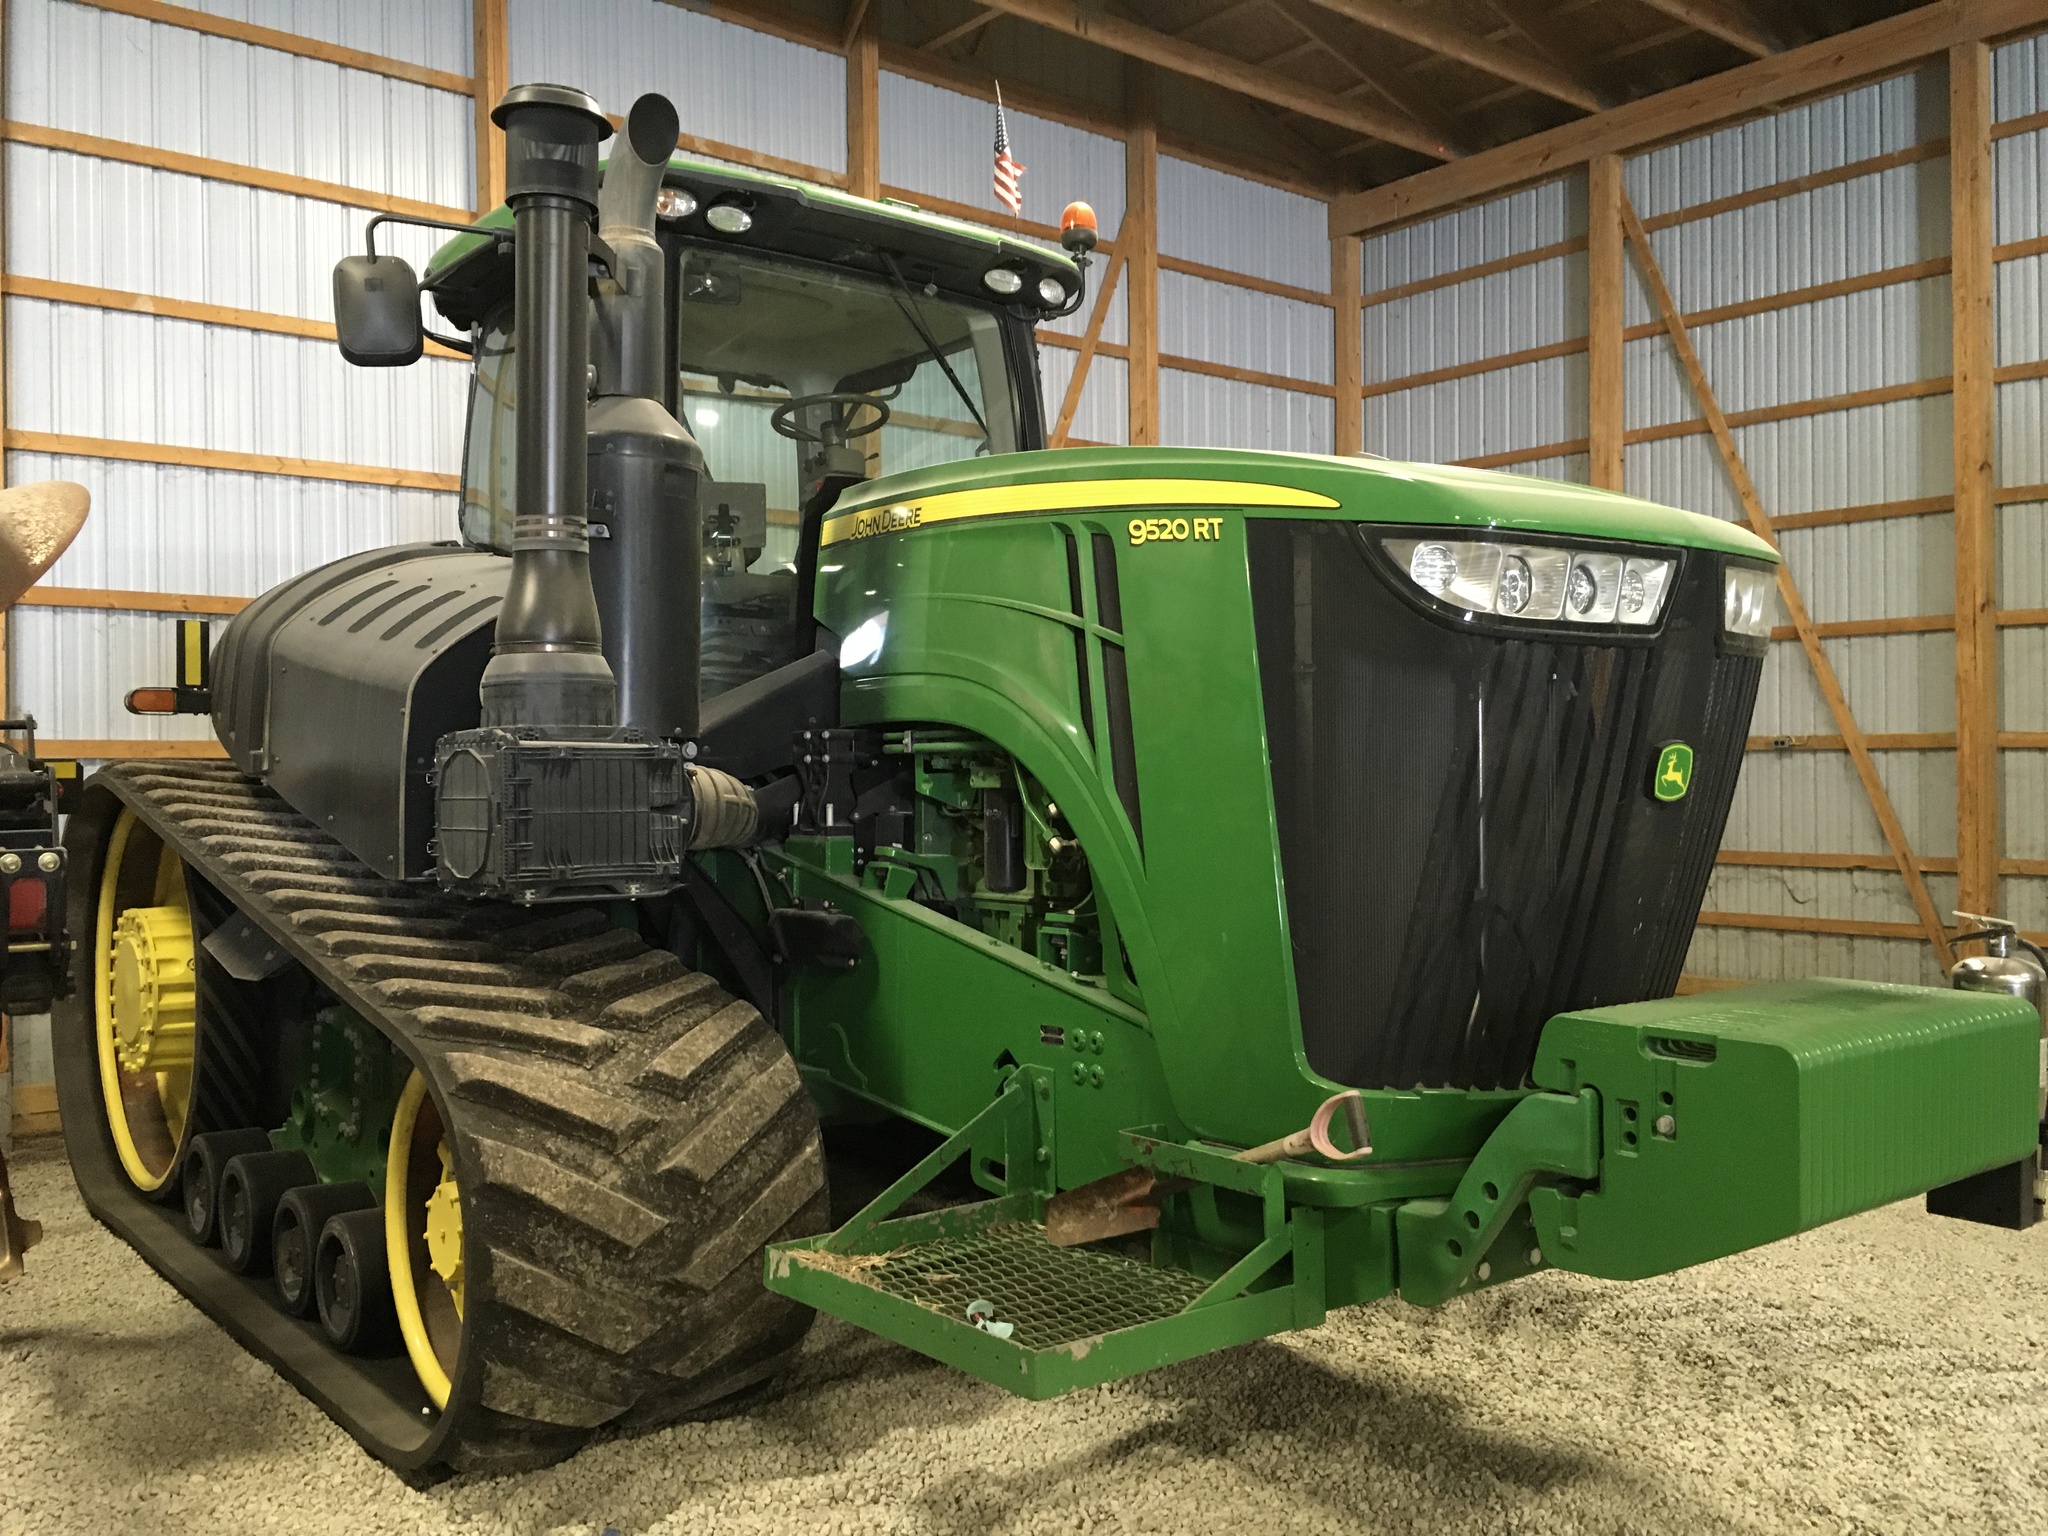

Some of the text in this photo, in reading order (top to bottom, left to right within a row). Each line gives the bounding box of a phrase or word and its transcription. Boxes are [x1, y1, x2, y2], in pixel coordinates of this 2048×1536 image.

[851, 506, 922, 538] JOHN DEERE
[1128, 517, 1224, 545] 9520 RT
